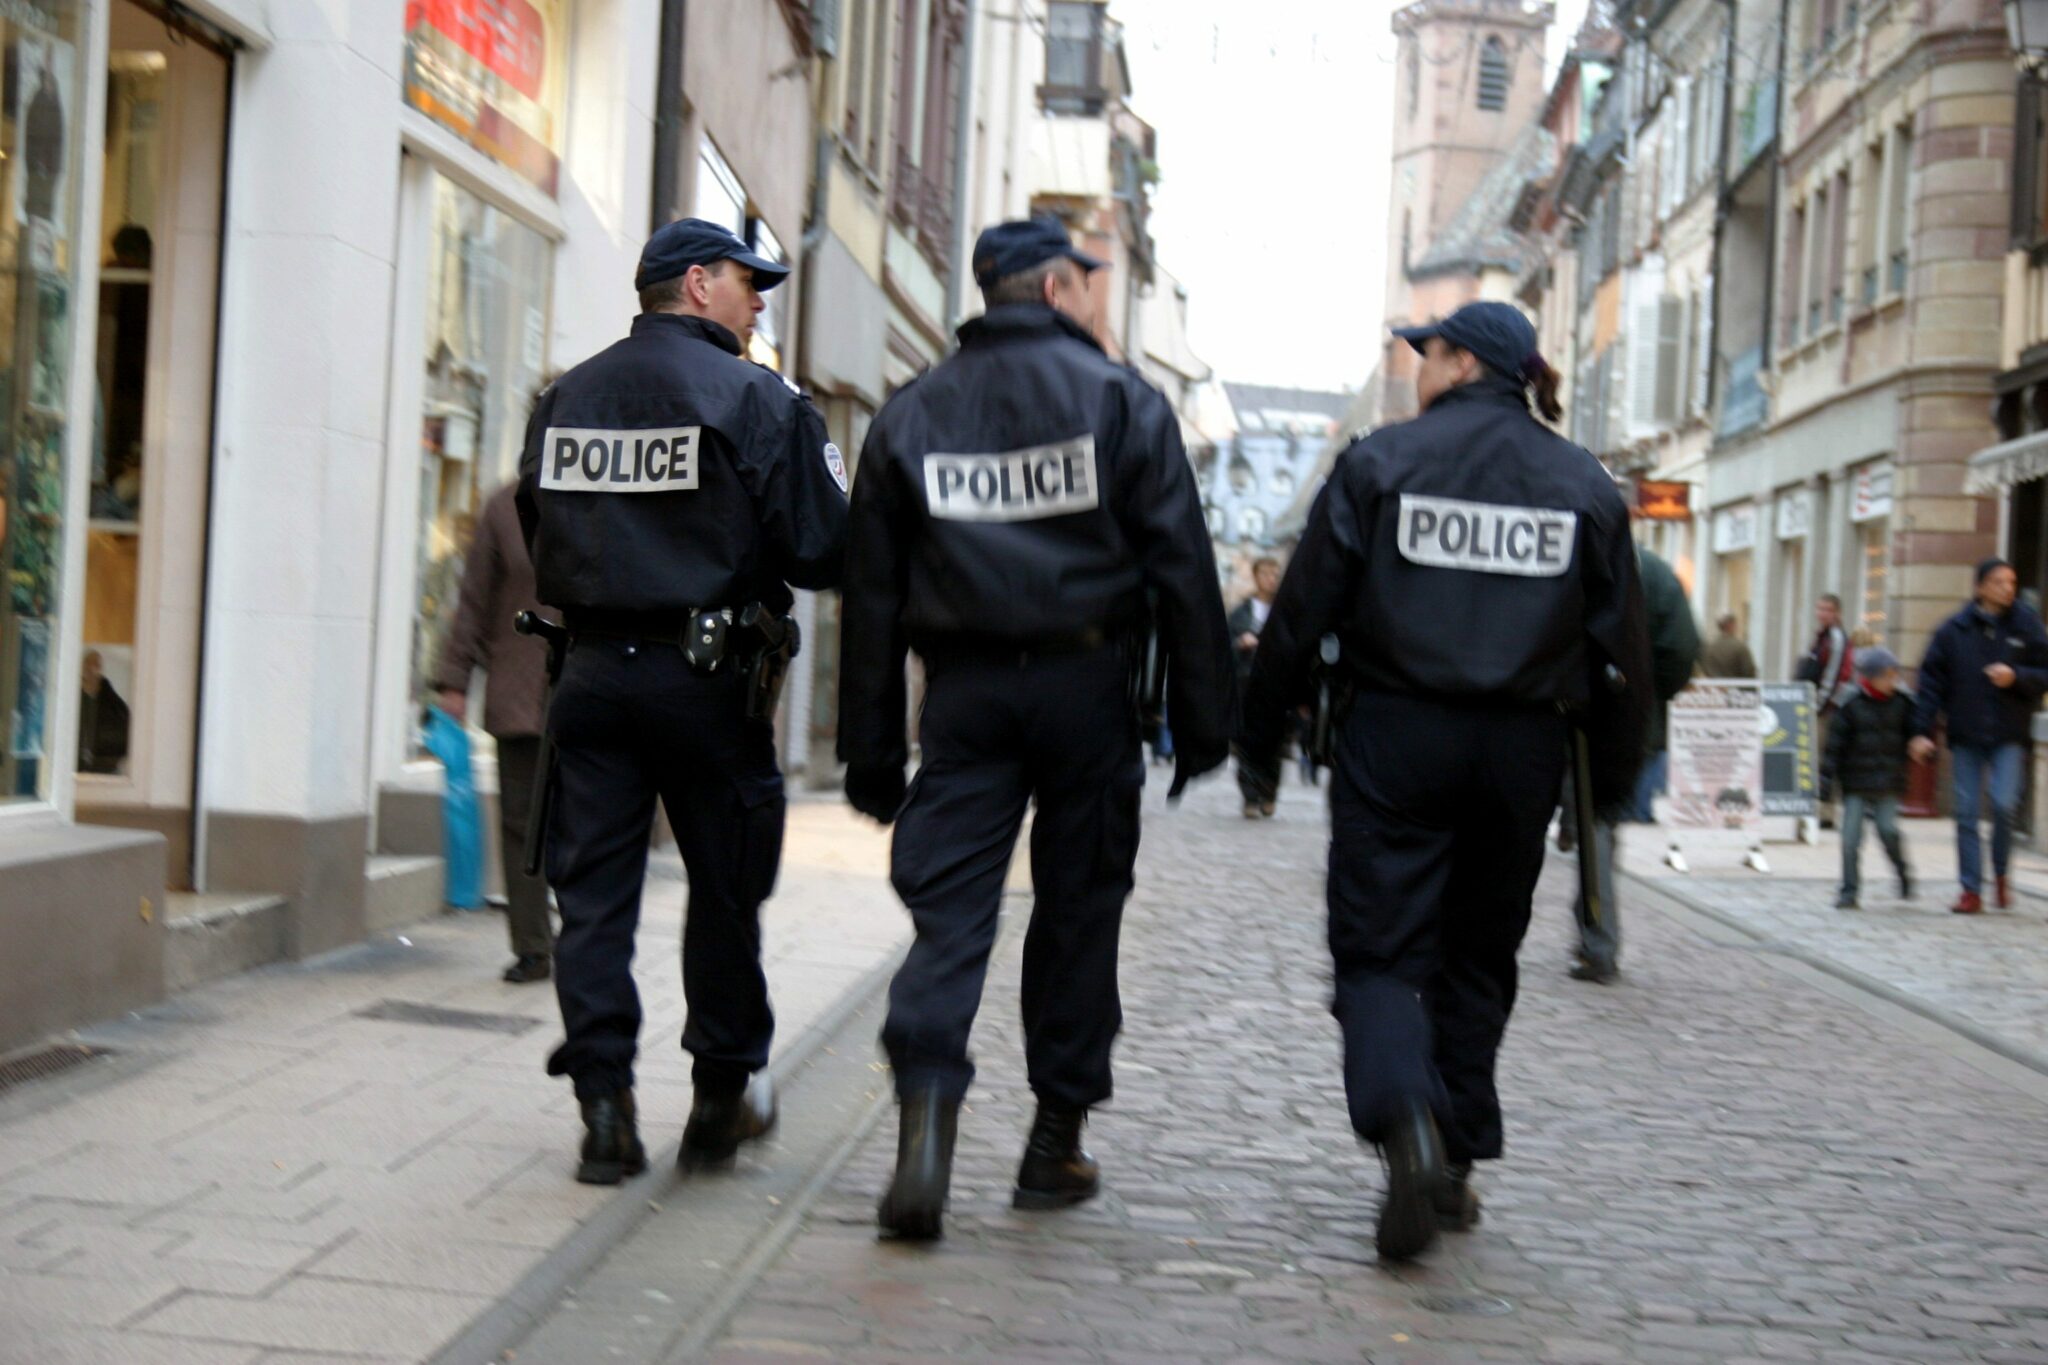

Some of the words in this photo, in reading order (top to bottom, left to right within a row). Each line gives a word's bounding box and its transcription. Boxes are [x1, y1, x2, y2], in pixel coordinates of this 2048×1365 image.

[553, 436, 690, 483] POLICE
[937, 450, 1088, 504] POLICE
[1408, 508, 1563, 565] POLICE
